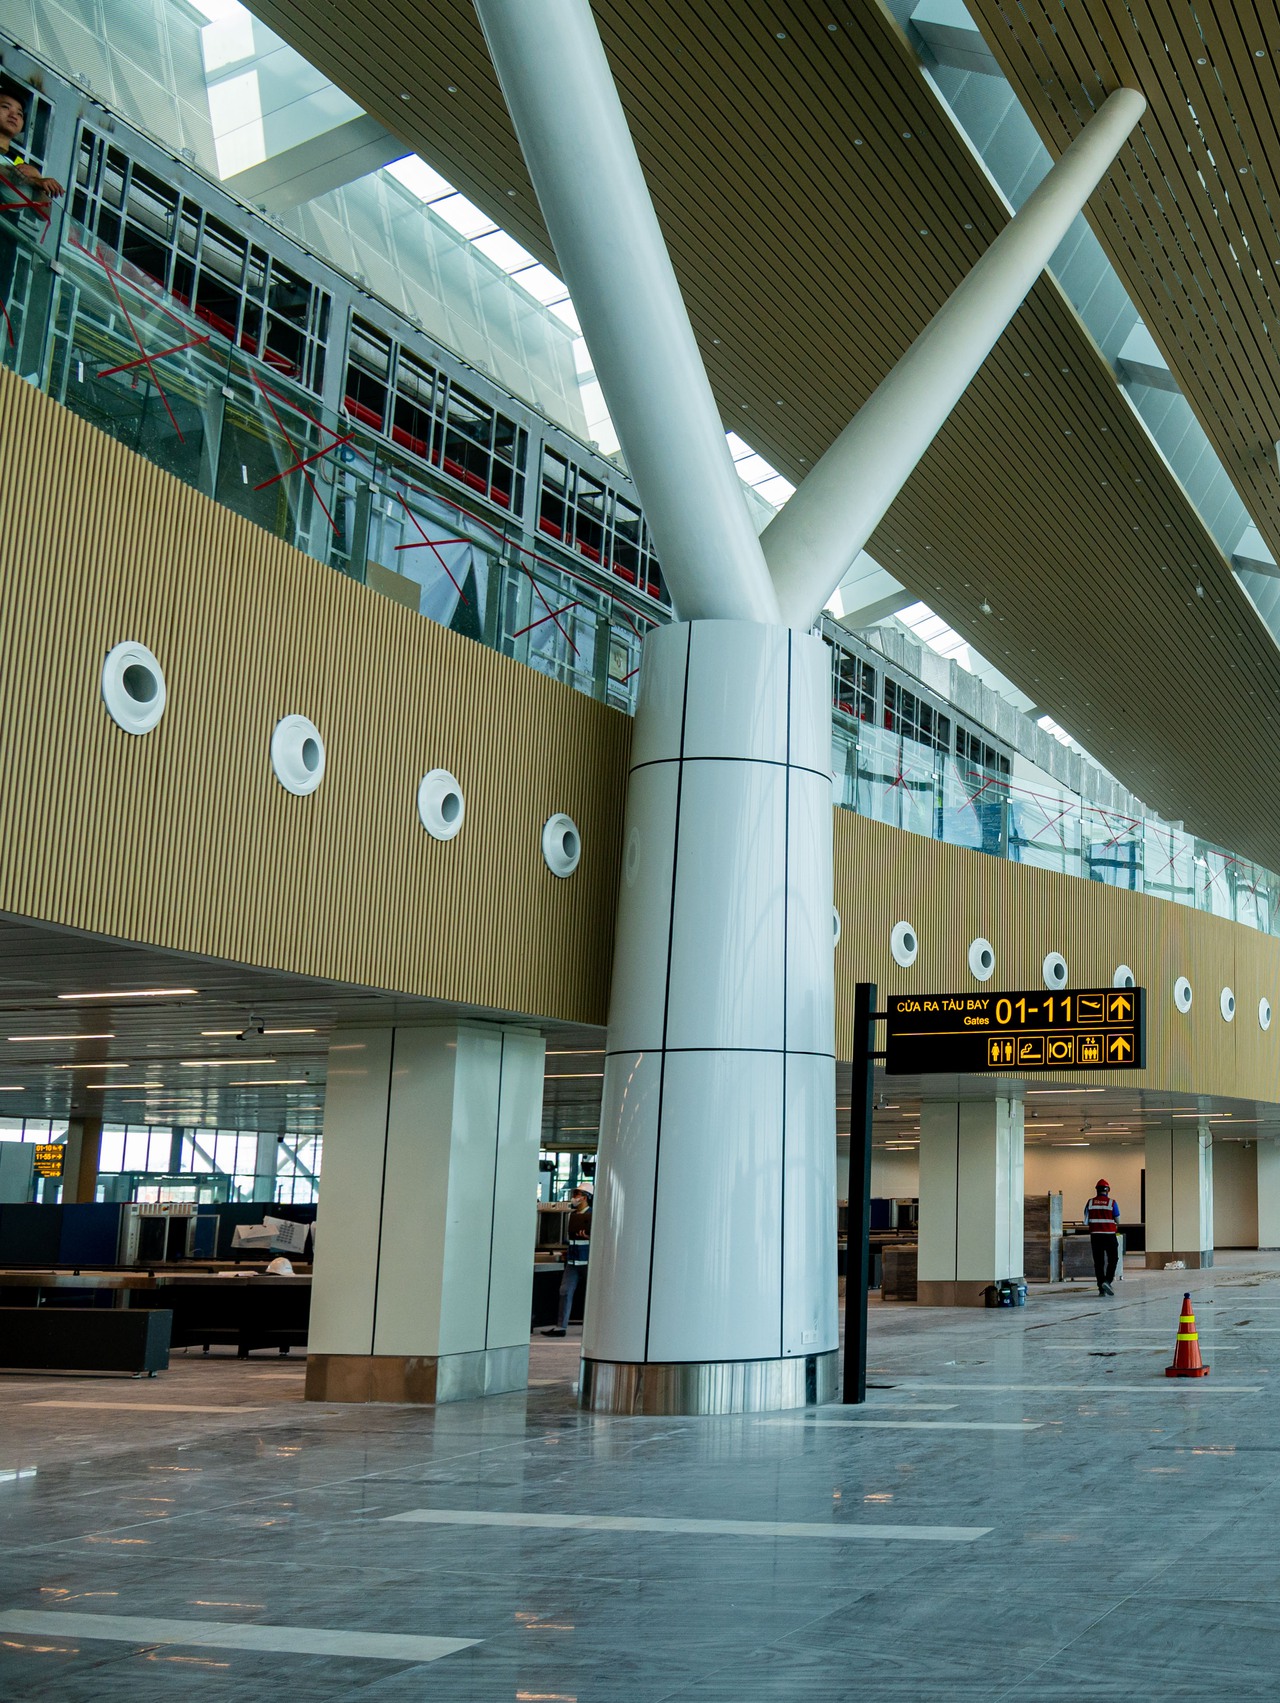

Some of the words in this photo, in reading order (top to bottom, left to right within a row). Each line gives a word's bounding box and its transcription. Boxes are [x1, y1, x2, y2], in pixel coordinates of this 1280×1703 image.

[897, 999, 921, 1012] CỬA
[923, 1001, 940, 1012] RA
[941, 998, 964, 1011] TÀU
[966, 999, 990, 1010] BAY
[995, 996, 1071, 1025] 01-11
[963, 1016, 990, 1026] Gates
